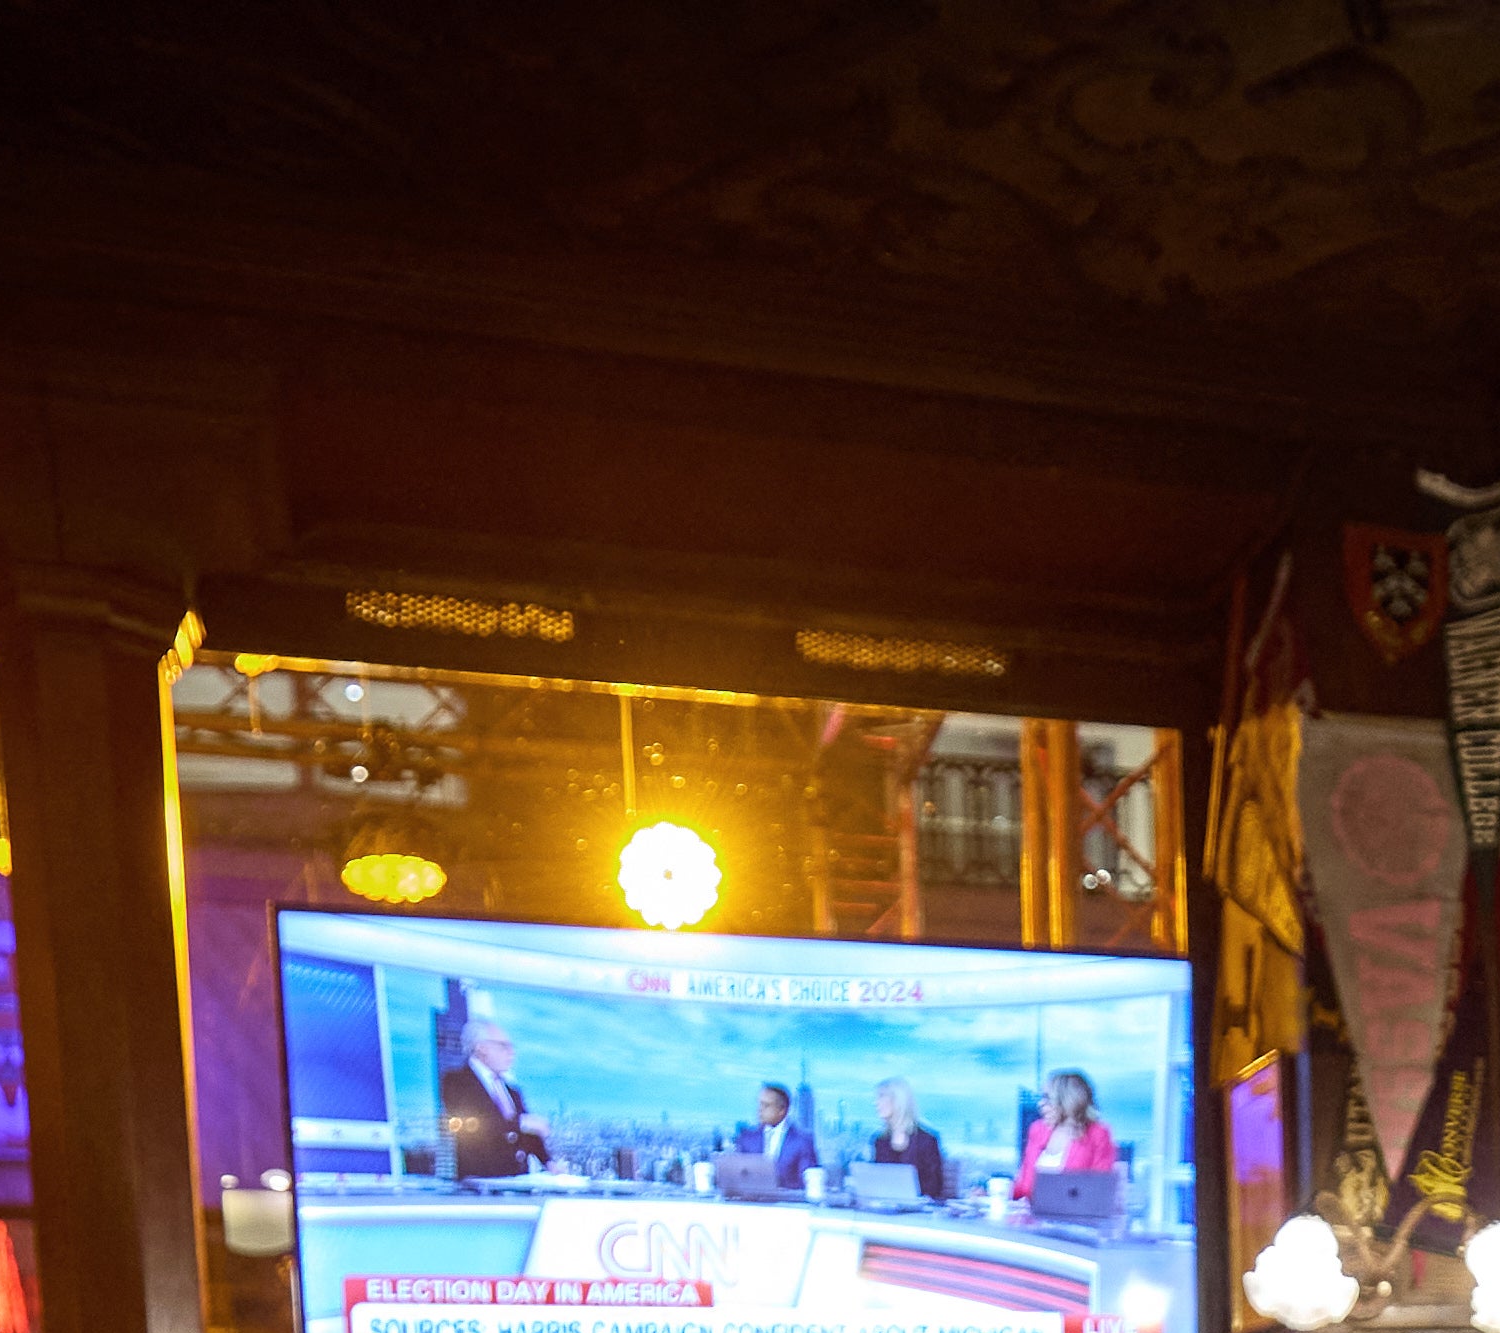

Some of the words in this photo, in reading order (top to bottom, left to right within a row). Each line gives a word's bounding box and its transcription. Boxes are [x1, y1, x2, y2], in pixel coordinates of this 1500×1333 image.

[789, 978, 851, 1003] CHOICE
[857, 979, 925, 1003] 2024
[597, 1220, 741, 1289] CNN
[366, 1278, 493, 1302] ELECTION
[495, 1280, 548, 1304] DAY
[554, 1281, 582, 1304] IN
[587, 1281, 702, 1305] AMERICA
